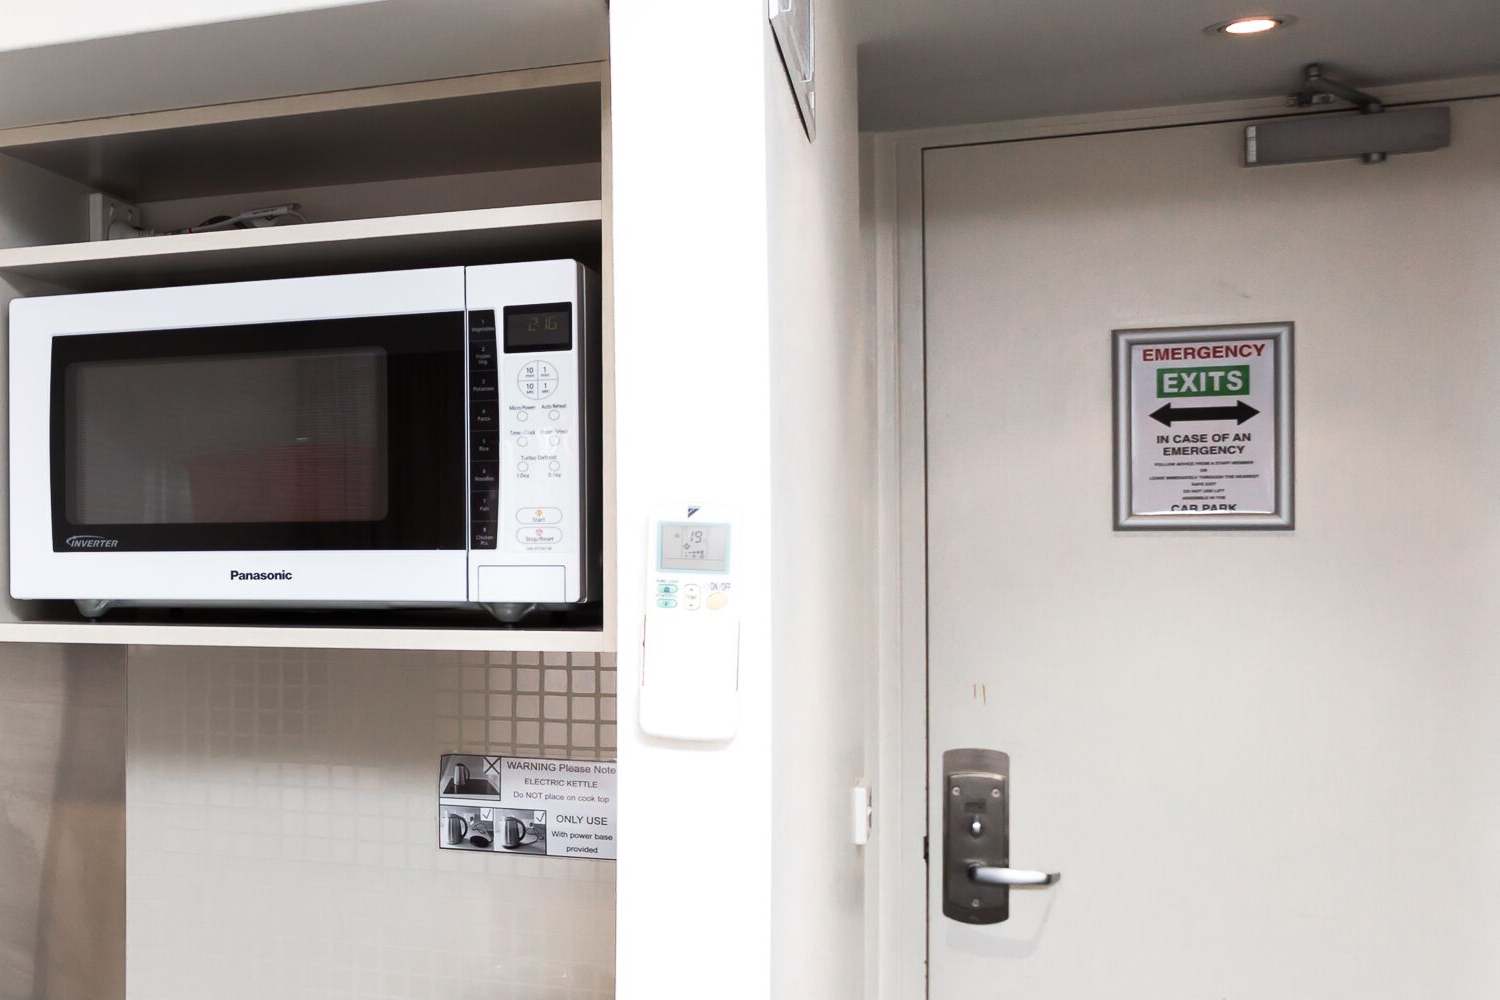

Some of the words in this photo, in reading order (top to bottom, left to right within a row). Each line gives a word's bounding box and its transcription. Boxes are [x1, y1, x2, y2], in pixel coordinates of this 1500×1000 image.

[1142, 344, 1265, 362] EMERGENCY
[1163, 370, 1244, 393] EXITS
[1156, 434, 1169, 444] IN
[1172, 434, 1208, 444] CASE
[1212, 433, 1229, 443] OF
[1232, 432, 1252, 442] AN
[1163, 445, 1245, 456] EMERGENCY
[1171, 504, 1198, 512] CAR
[1202, 503, 1237, 511] PARK
[69, 538, 118, 548] INVERTER
[230, 569, 292, 581] Panasonic
[507, 761, 556, 772] WARNING
[558, 763, 591, 773] Please
[593, 765, 617, 774] Note
[524, 778, 565, 787] ELECTRIC
[566, 780, 598, 788] KETTLE
[513, 791, 524, 799] Do
[544, 793, 565, 801] place
[556, 814, 584, 824] ONLY
[586, 816, 608, 826] USE
[551, 830, 568, 838] With
[569, 832, 593, 840] power
[594, 832, 613, 841] base
[566, 845, 598, 854] provided
